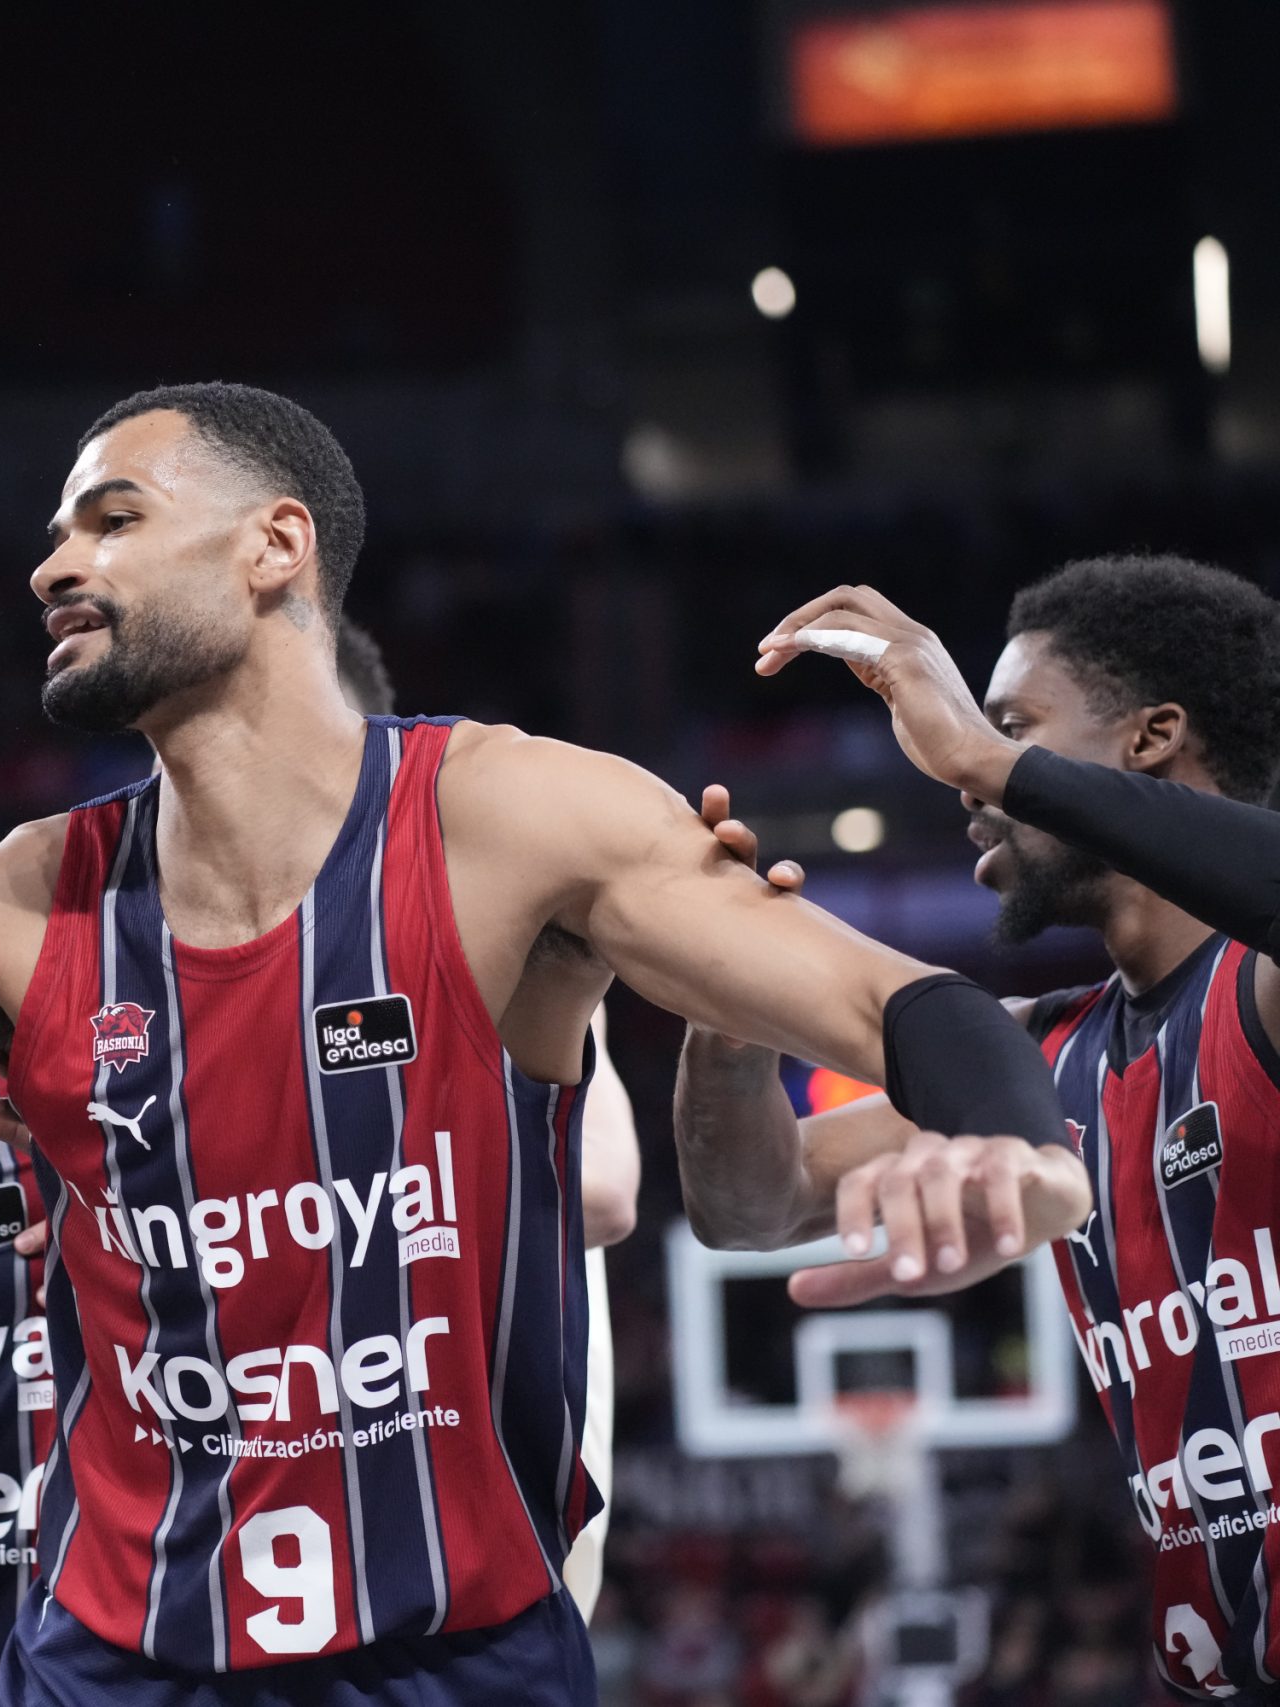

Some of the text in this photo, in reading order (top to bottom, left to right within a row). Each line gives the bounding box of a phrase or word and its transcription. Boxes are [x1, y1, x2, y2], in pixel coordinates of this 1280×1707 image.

[323, 1025, 361, 1046] liga
[326, 1038, 409, 1063] endesa
[1163, 1139, 1186, 1162] liga
[1165, 1142, 1219, 1178] endesa
[65, 1131, 458, 1288] kingroyal
[403, 1231, 455, 1260] .media
[201, 1404, 460, 1459] Climatización eficiente
[238, 1505, 337, 1654] 9
